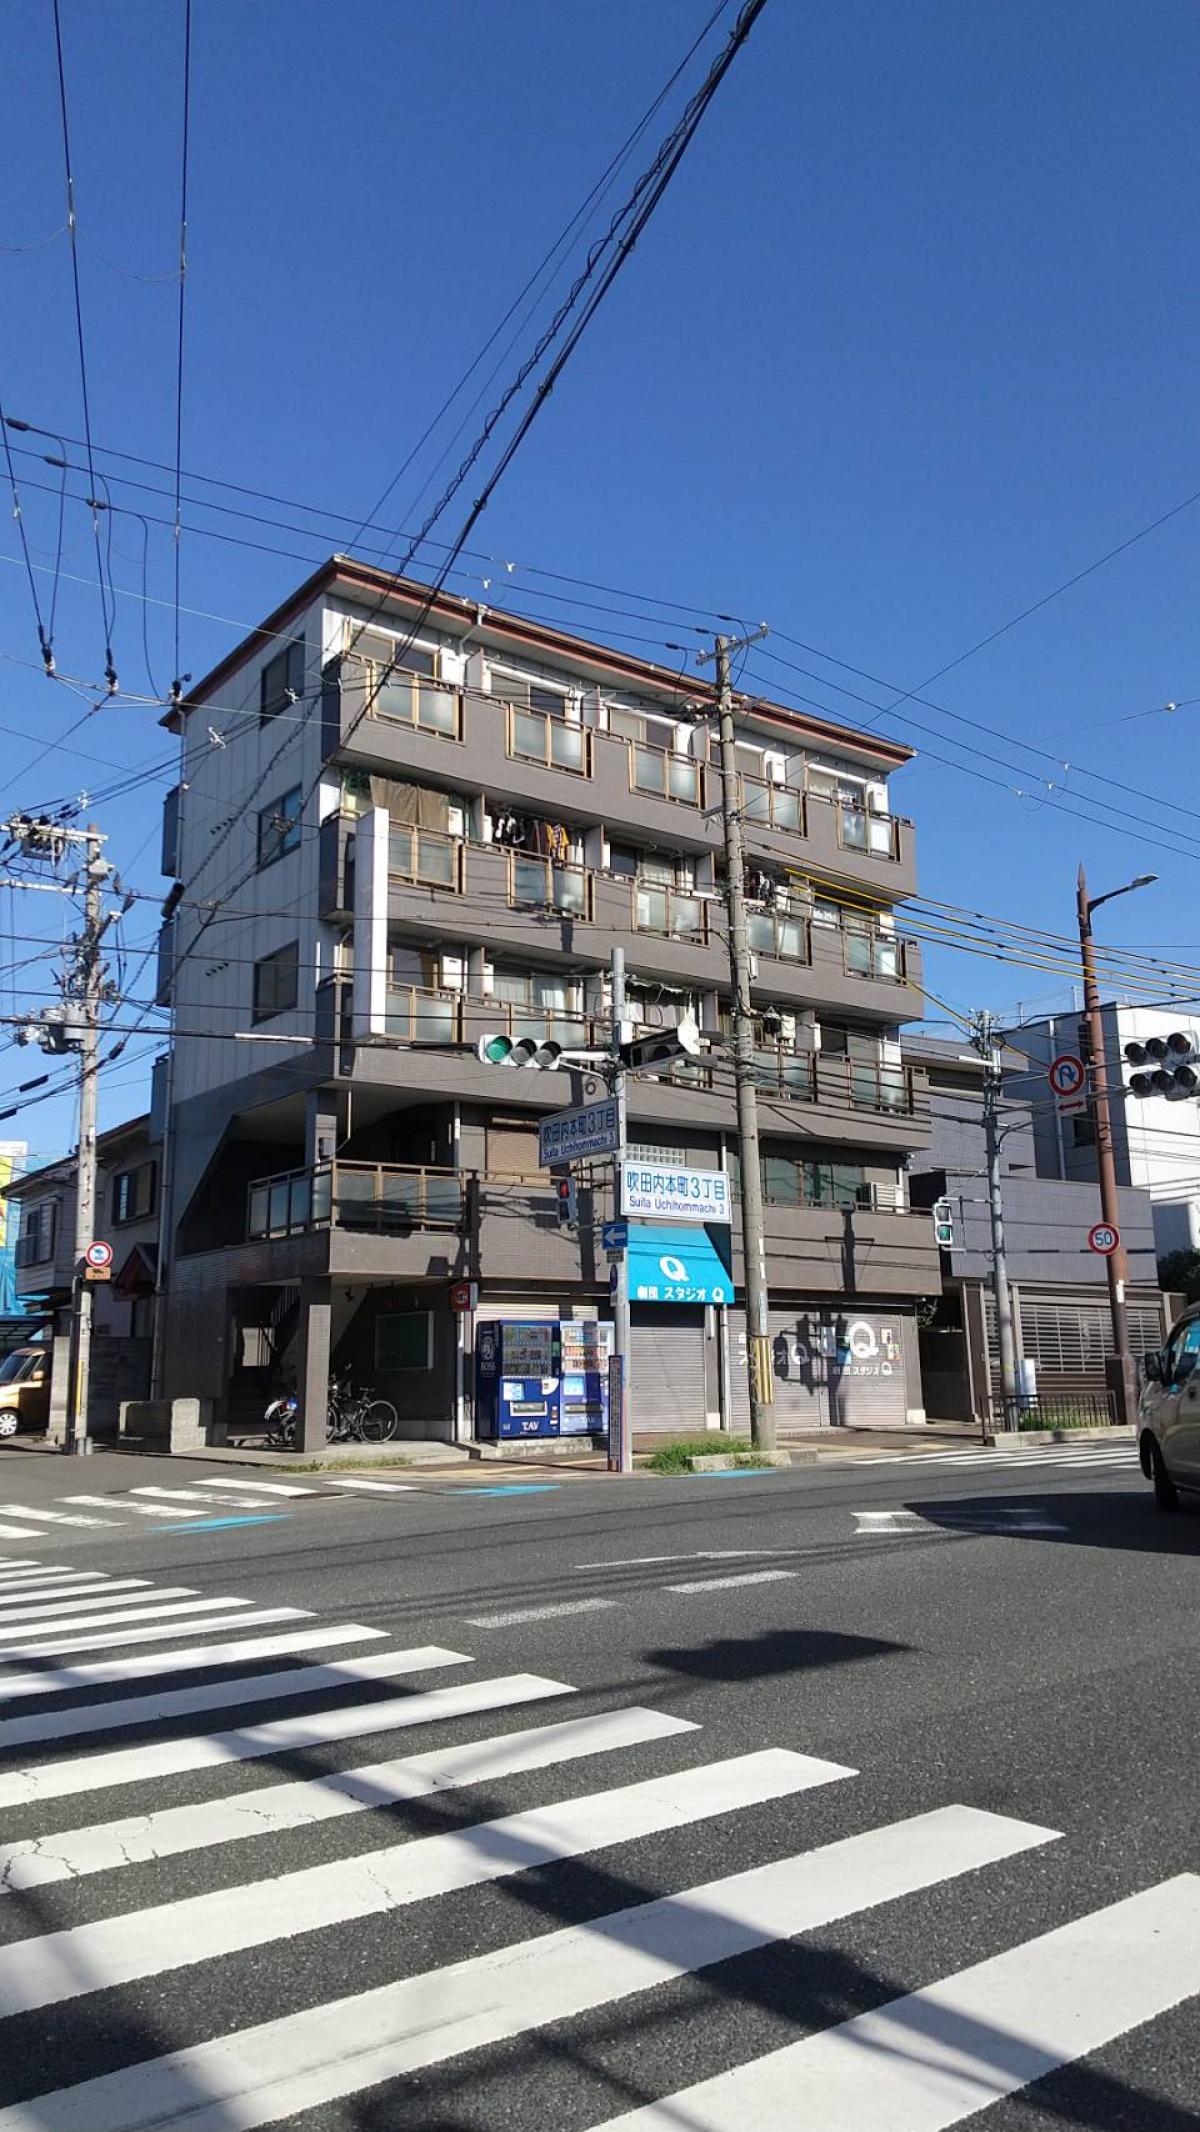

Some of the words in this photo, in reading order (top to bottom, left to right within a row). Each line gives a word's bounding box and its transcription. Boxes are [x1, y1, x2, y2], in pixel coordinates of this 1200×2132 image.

[609, 1131, 615, 1142] 3
[627, 1171, 725, 1200] 吹田内本町3丁目
[629, 1195, 651, 1207] Suita
[719, 1203, 725, 1214] 3
[1095, 1231, 1112, 1246] 50
[659, 1256, 690, 1282] Q
[664, 1286, 706, 1301] スタジオ
[712, 1287, 724, 1302] Q
[849, 1321, 879, 1359] Q
[881, 1361, 893, 1376] Q
